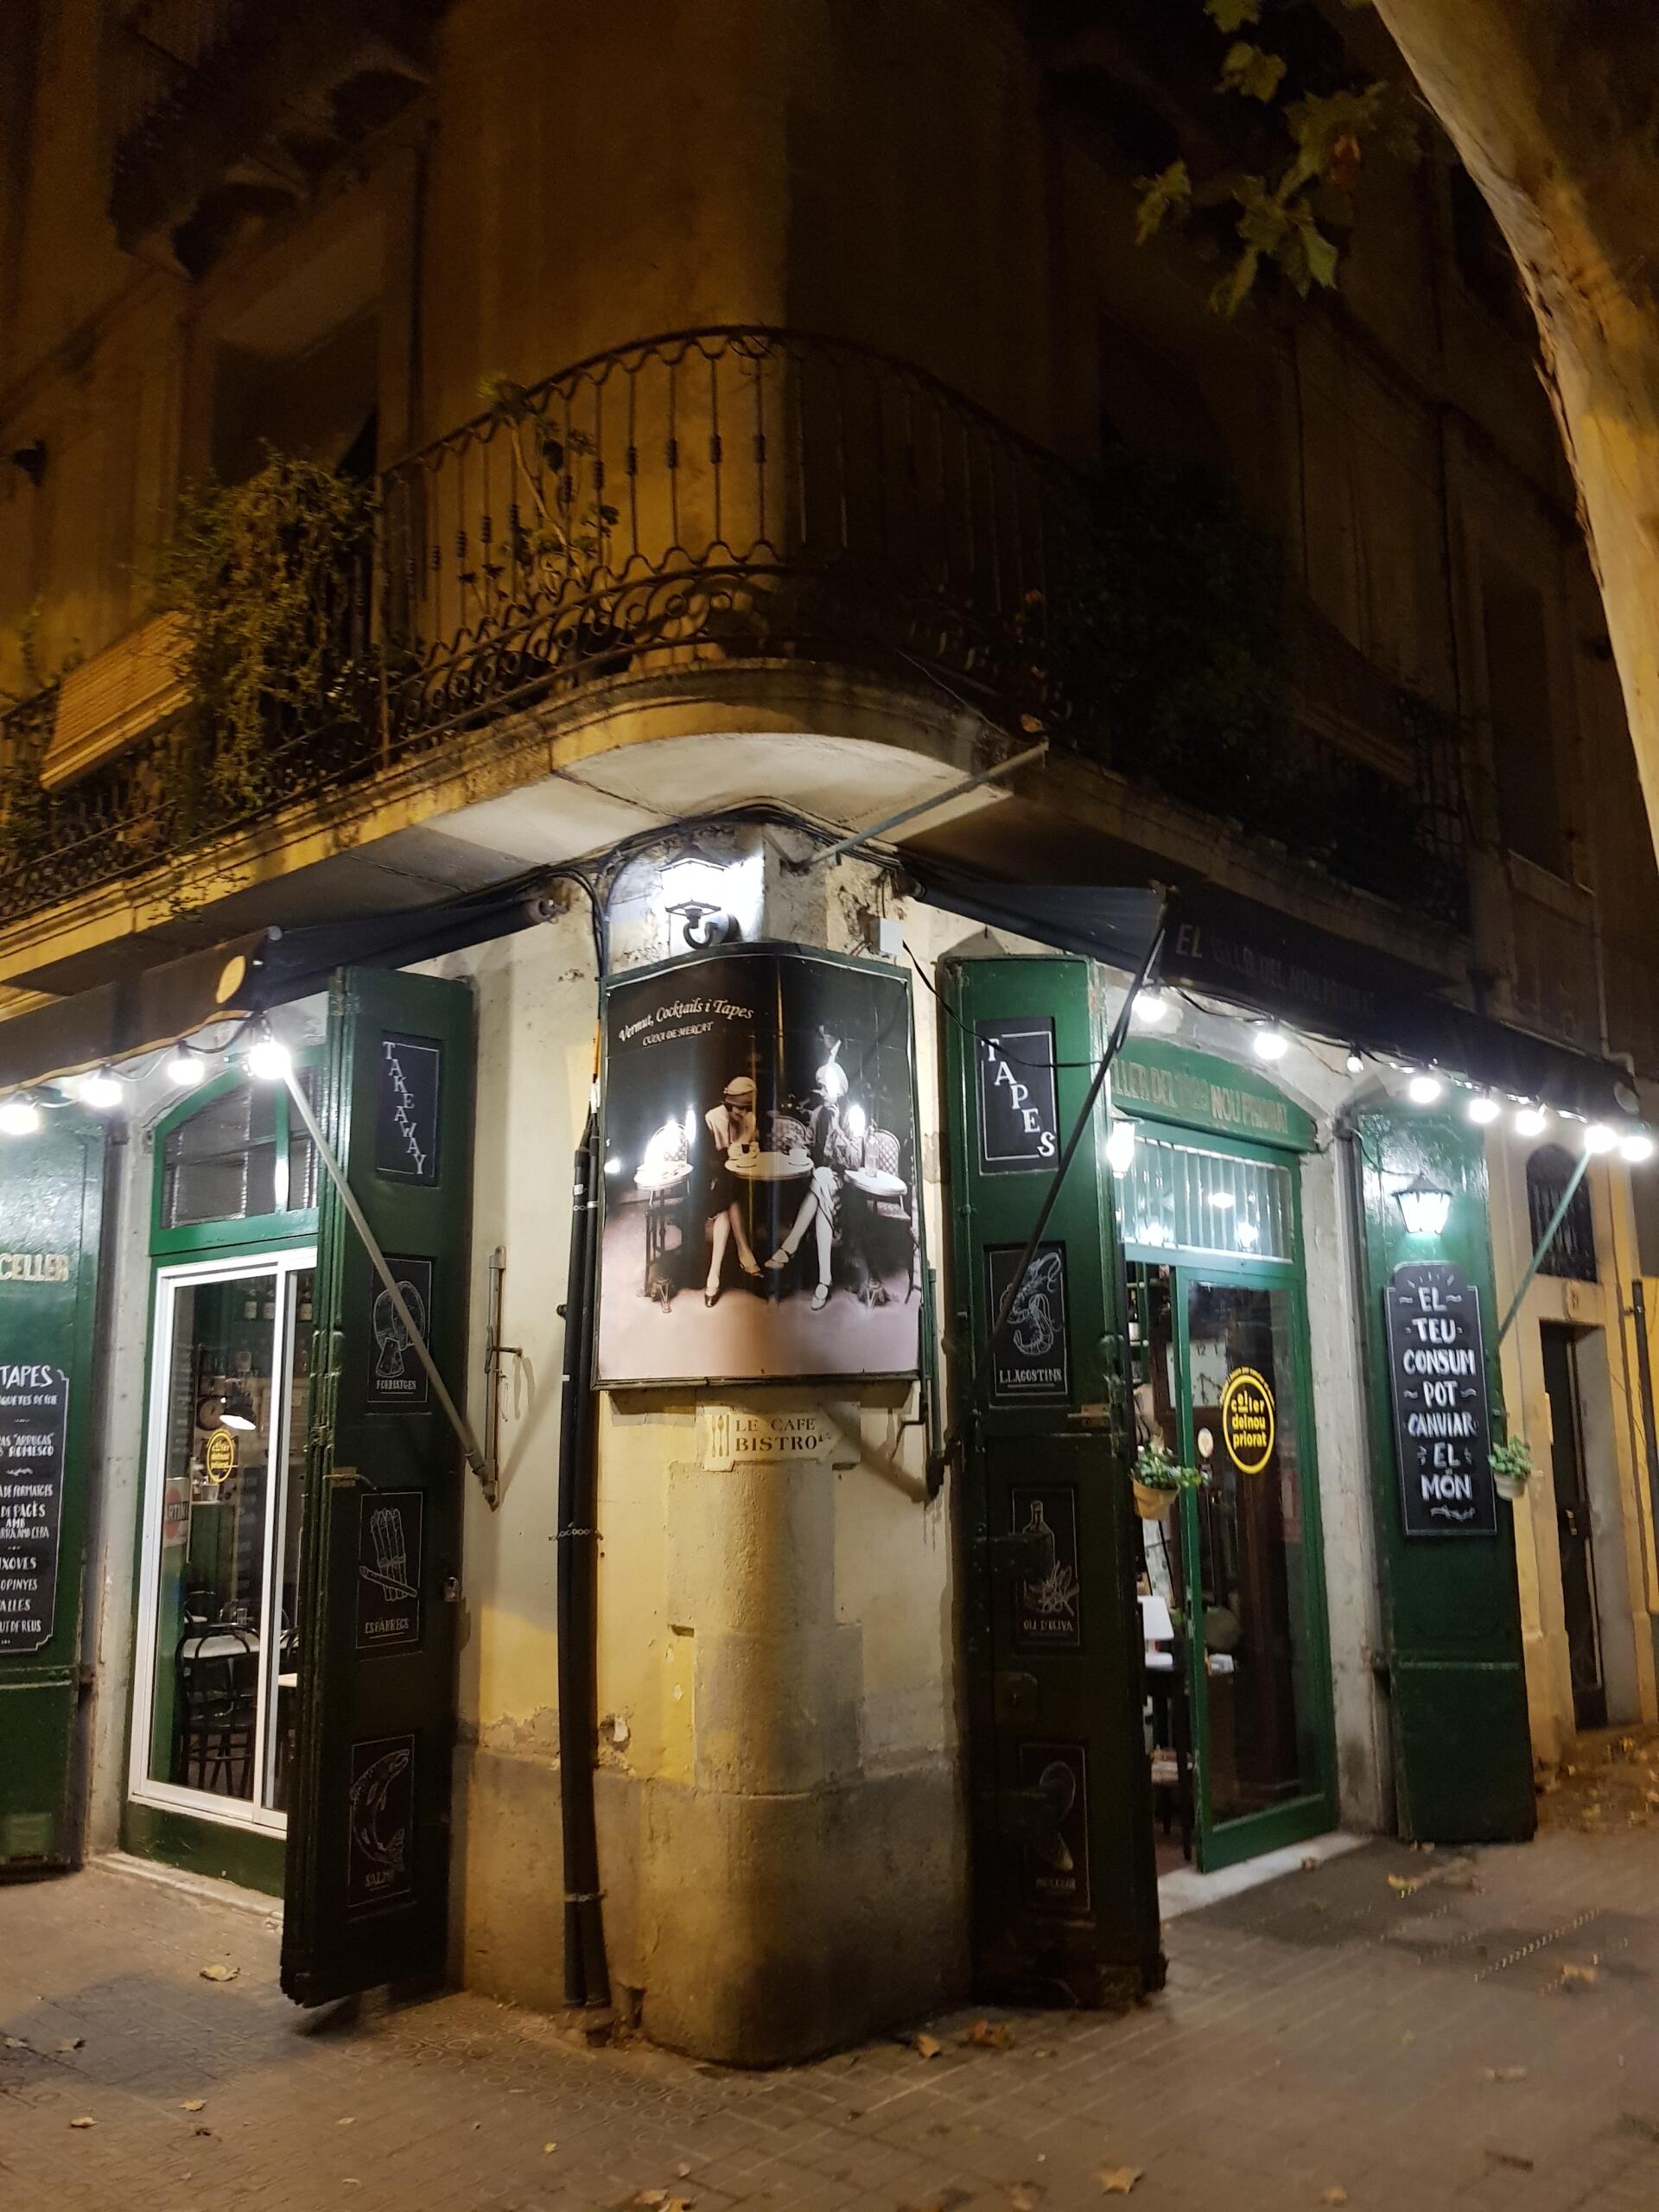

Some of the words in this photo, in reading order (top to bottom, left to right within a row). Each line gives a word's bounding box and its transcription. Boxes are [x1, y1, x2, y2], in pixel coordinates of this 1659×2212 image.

[1176, 923, 1203, 958] EL
[656, 997, 703, 1022] Cocktails
[705, 999, 710, 1013] i
[714, 999, 754, 1020] Tapes
[982, 1039, 1057, 1157] TAPES
[0, 1253, 69, 1281] CELLER
[1418, 1286, 1447, 1312] EL
[1412, 1318, 1457, 1344] TEU
[1403, 1349, 1476, 1376] CONSUM
[0, 1364, 53, 1389] TAPES
[1423, 1381, 1457, 1408] POT
[736, 1419, 758, 1432] LE
[1408, 1412, 1475, 1438] CANVIAR
[1433, 1442, 1461, 1468] EL
[0, 1556, 36, 1570] XOVES
